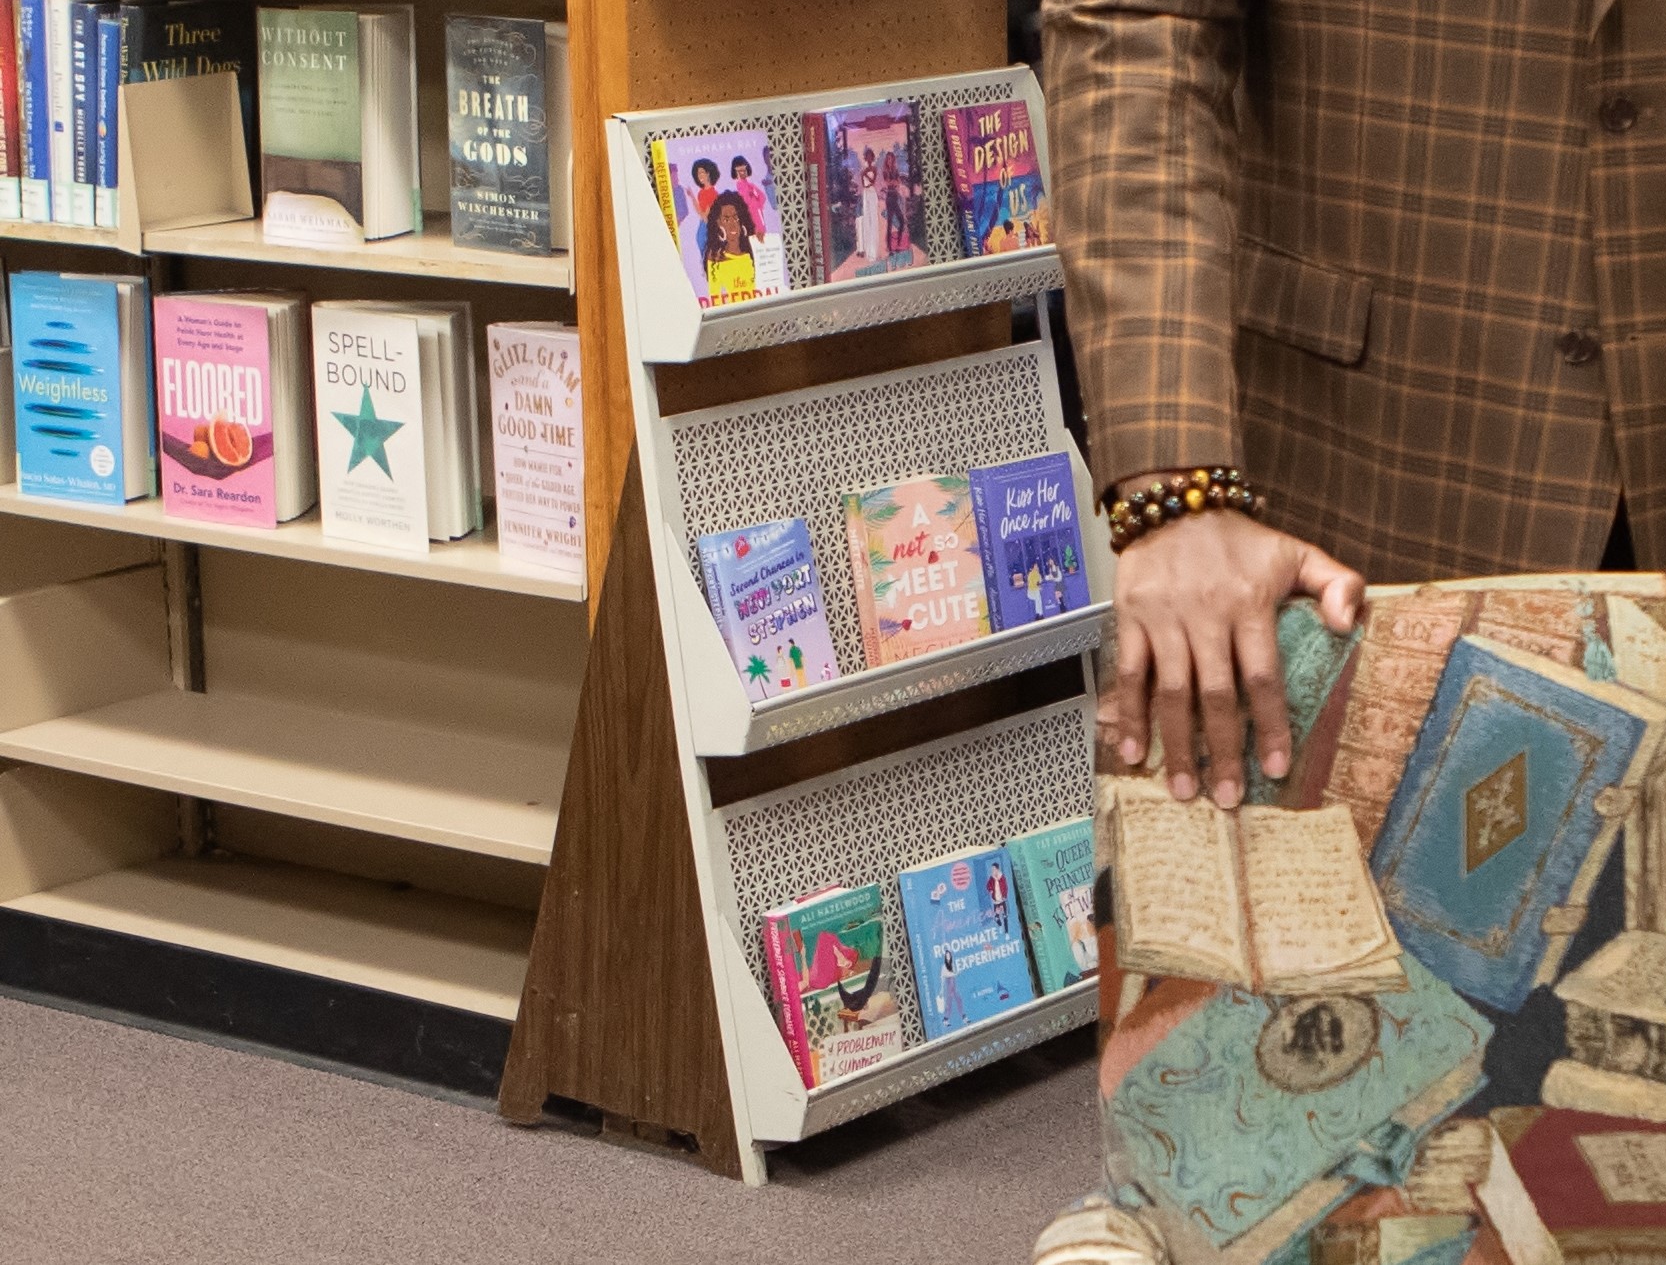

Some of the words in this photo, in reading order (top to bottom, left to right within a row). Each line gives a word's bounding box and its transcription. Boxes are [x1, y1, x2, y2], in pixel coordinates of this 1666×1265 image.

[166, 23, 222, 46] Three
[261, 26, 347, 47] WITHOUT
[73, 40, 85, 68] ART
[261, 50, 347, 71] CONSENT
[74, 73, 86, 102] SPY
[459, 89, 530, 123] BREATH
[978, 109, 1002, 137] THE
[462, 139, 529, 167] GODS
[974, 128, 1030, 174] DESIGN
[457, 200, 541, 222] WINCHESTER
[475, 190, 516, 205] SIMON
[1008, 182, 1028, 217] US
[328, 331, 403, 363] SPELL-
[493, 342, 534, 379] GLITZ,
[18, 372, 109, 403] Weightless
[162, 357, 263, 426] FLOORED
[326, 362, 407, 394] BOUND
[514, 390, 553, 417] DAMN
[497, 415, 537, 442] GOOD
[540, 422, 576, 448] TIME
[173, 483, 189, 496] Dr.
[191, 484, 213, 500] Sara
[216, 488, 262, 505] Reardon
[1005, 486, 1035, 516] Kiss
[1036, 478, 1061, 504] Her
[911, 502, 931, 529] A
[1001, 514, 1032, 540] Once
[1032, 514, 1048, 532] for
[1050, 502, 1073, 529] Me
[892, 530, 931, 562] not
[883, 560, 960, 609] MEET
[906, 592, 981, 631] CUTE
[1054, 839, 1093, 873] QUEER
[947, 897, 966, 913] THE
[933, 926, 999, 959] ROOMMATE
[954, 938, 1021, 976] EXPERIMENT
